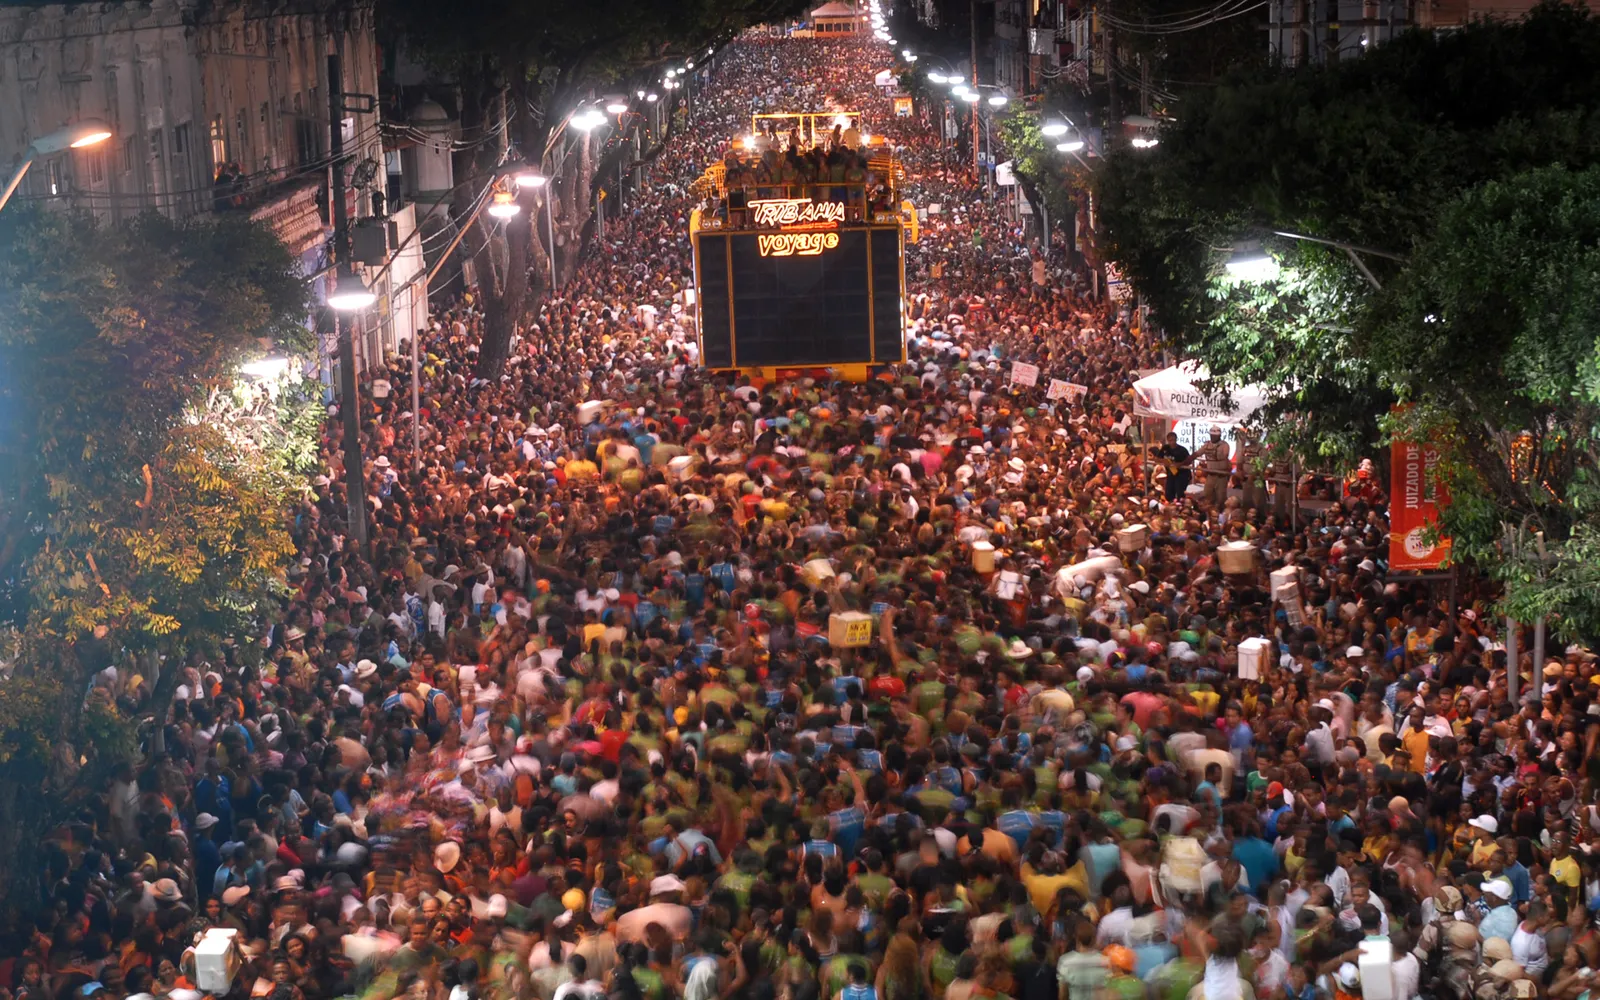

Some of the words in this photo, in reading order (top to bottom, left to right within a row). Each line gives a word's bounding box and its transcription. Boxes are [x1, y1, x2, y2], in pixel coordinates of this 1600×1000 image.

[1206, 396, 1240, 410] MILAR
[1191, 407, 1208, 417] PEO
[1406, 445, 1419, 460] DE
[1405, 462, 1419, 509] JUIZADO
